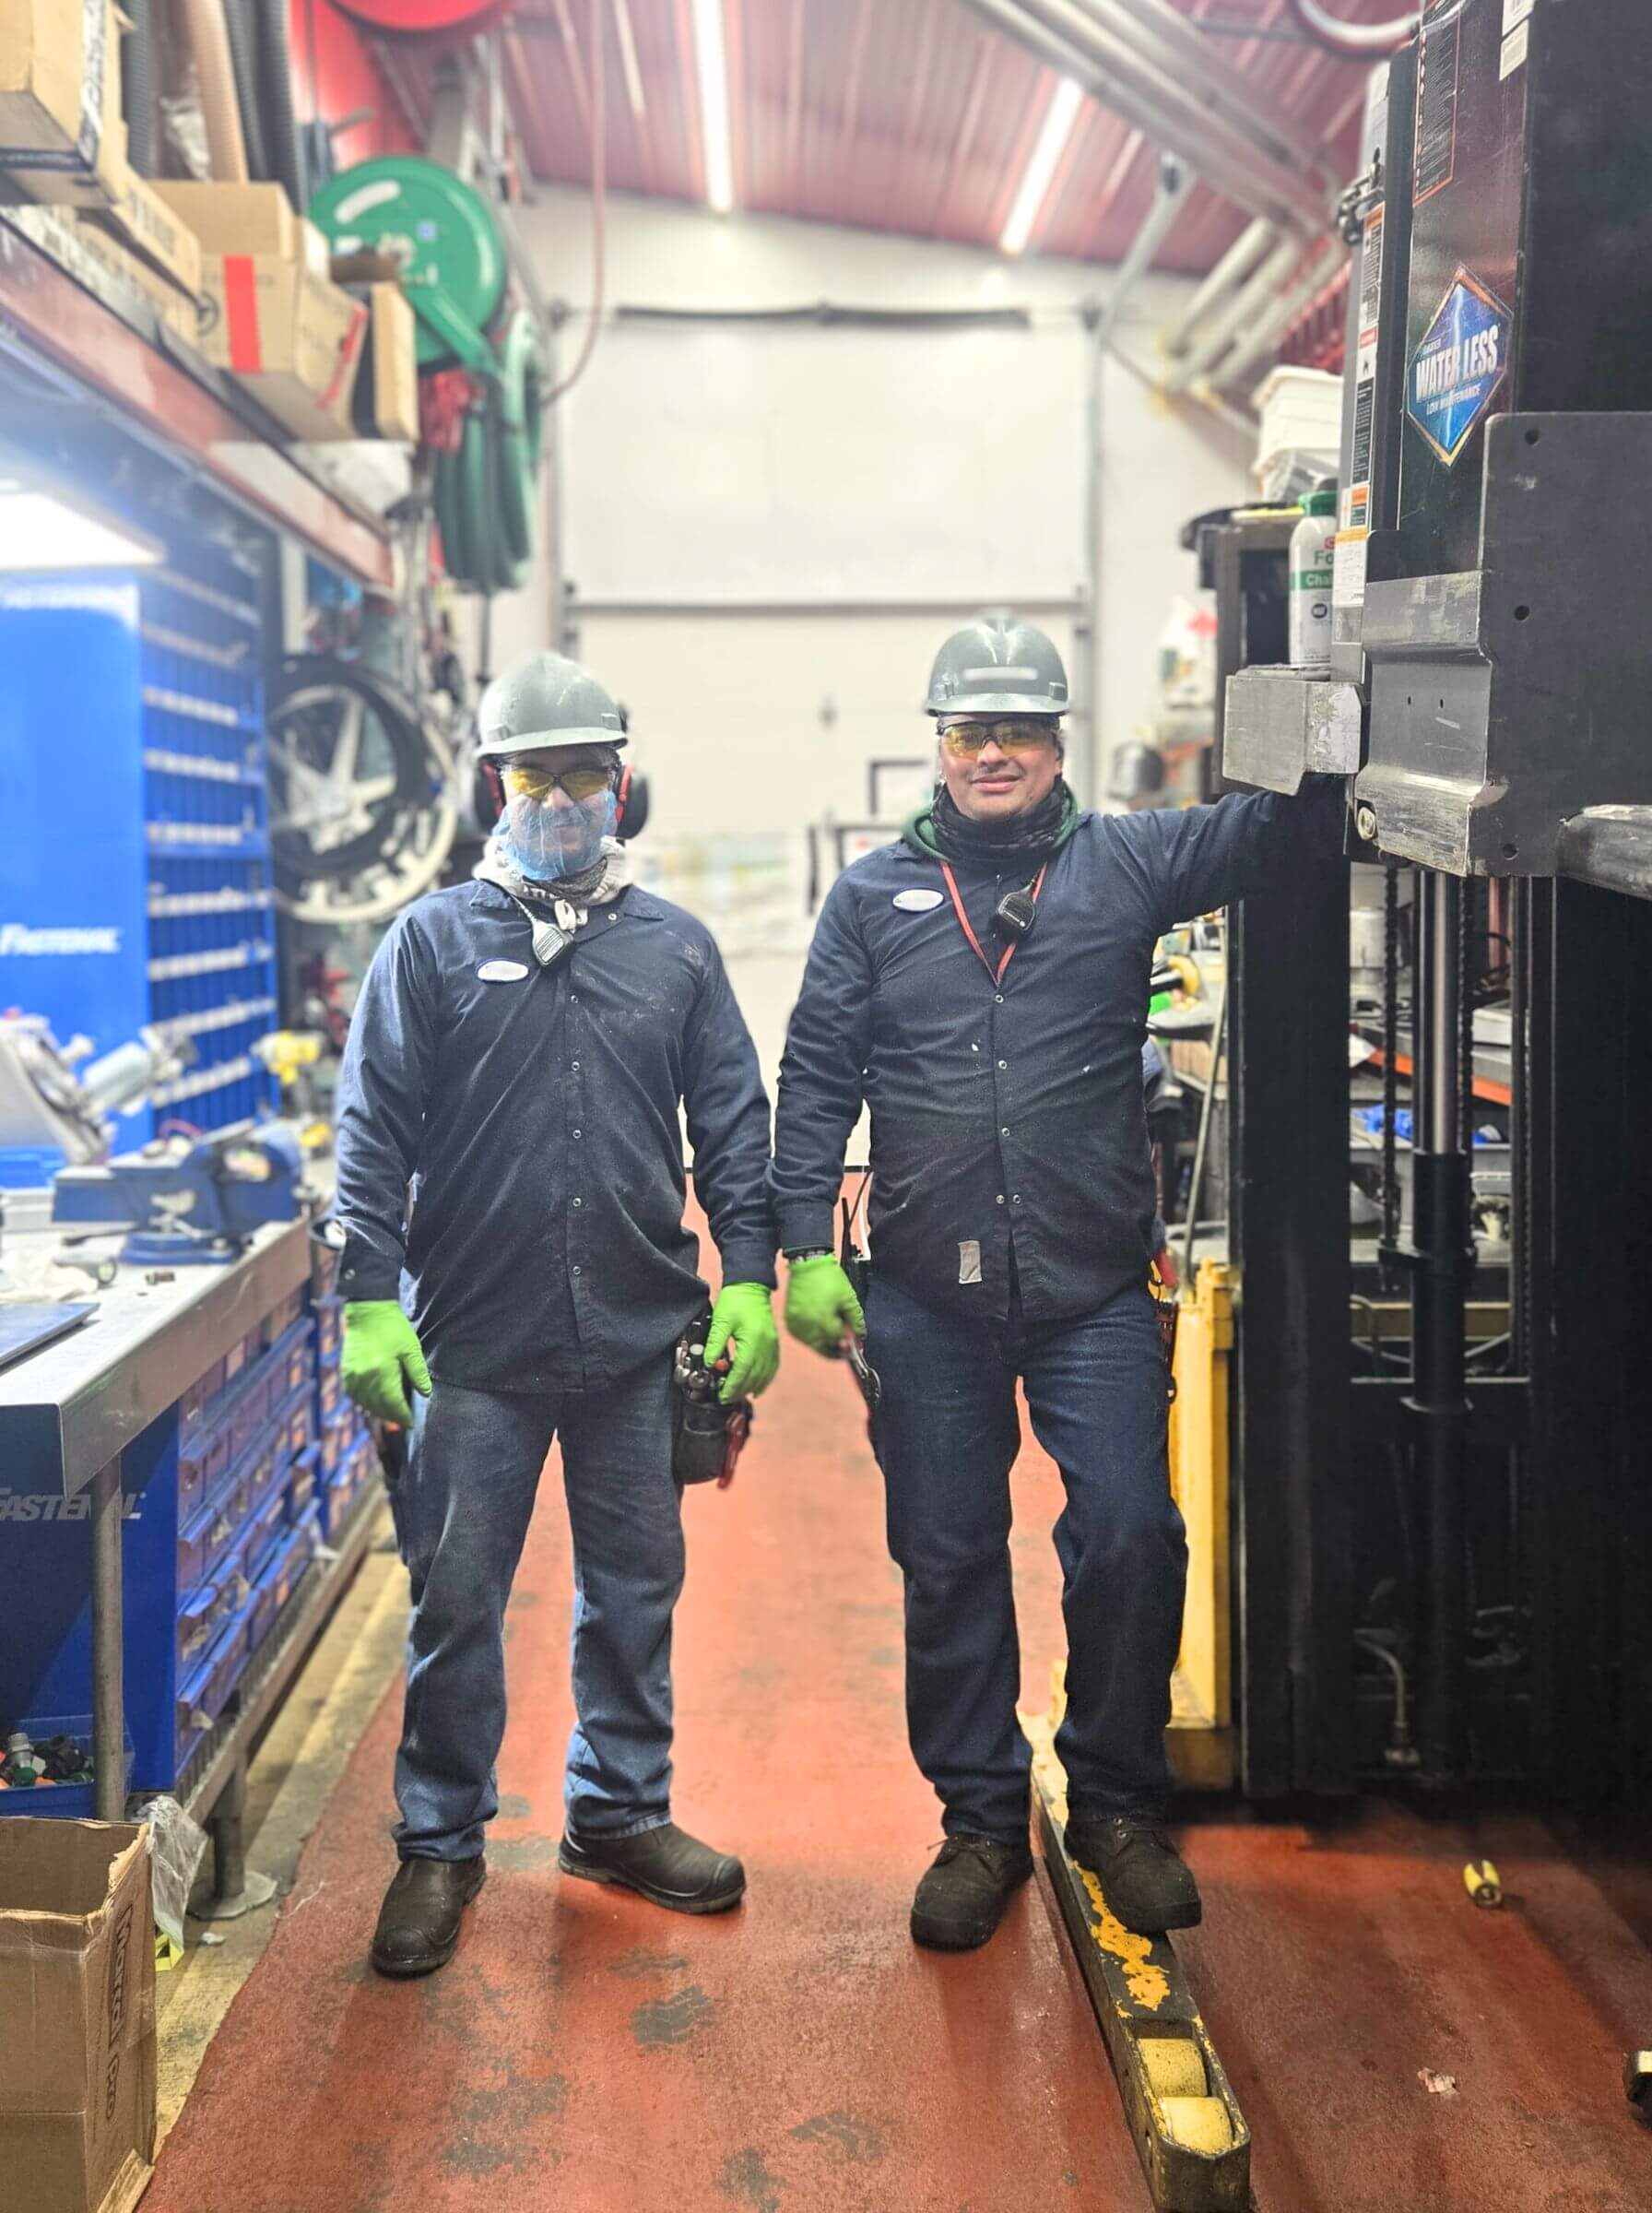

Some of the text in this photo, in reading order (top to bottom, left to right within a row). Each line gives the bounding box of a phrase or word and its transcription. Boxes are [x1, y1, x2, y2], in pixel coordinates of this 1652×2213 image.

[1416, 324, 1499, 404] WATER LESS
[0, 1486, 142, 1521] ASTEL
